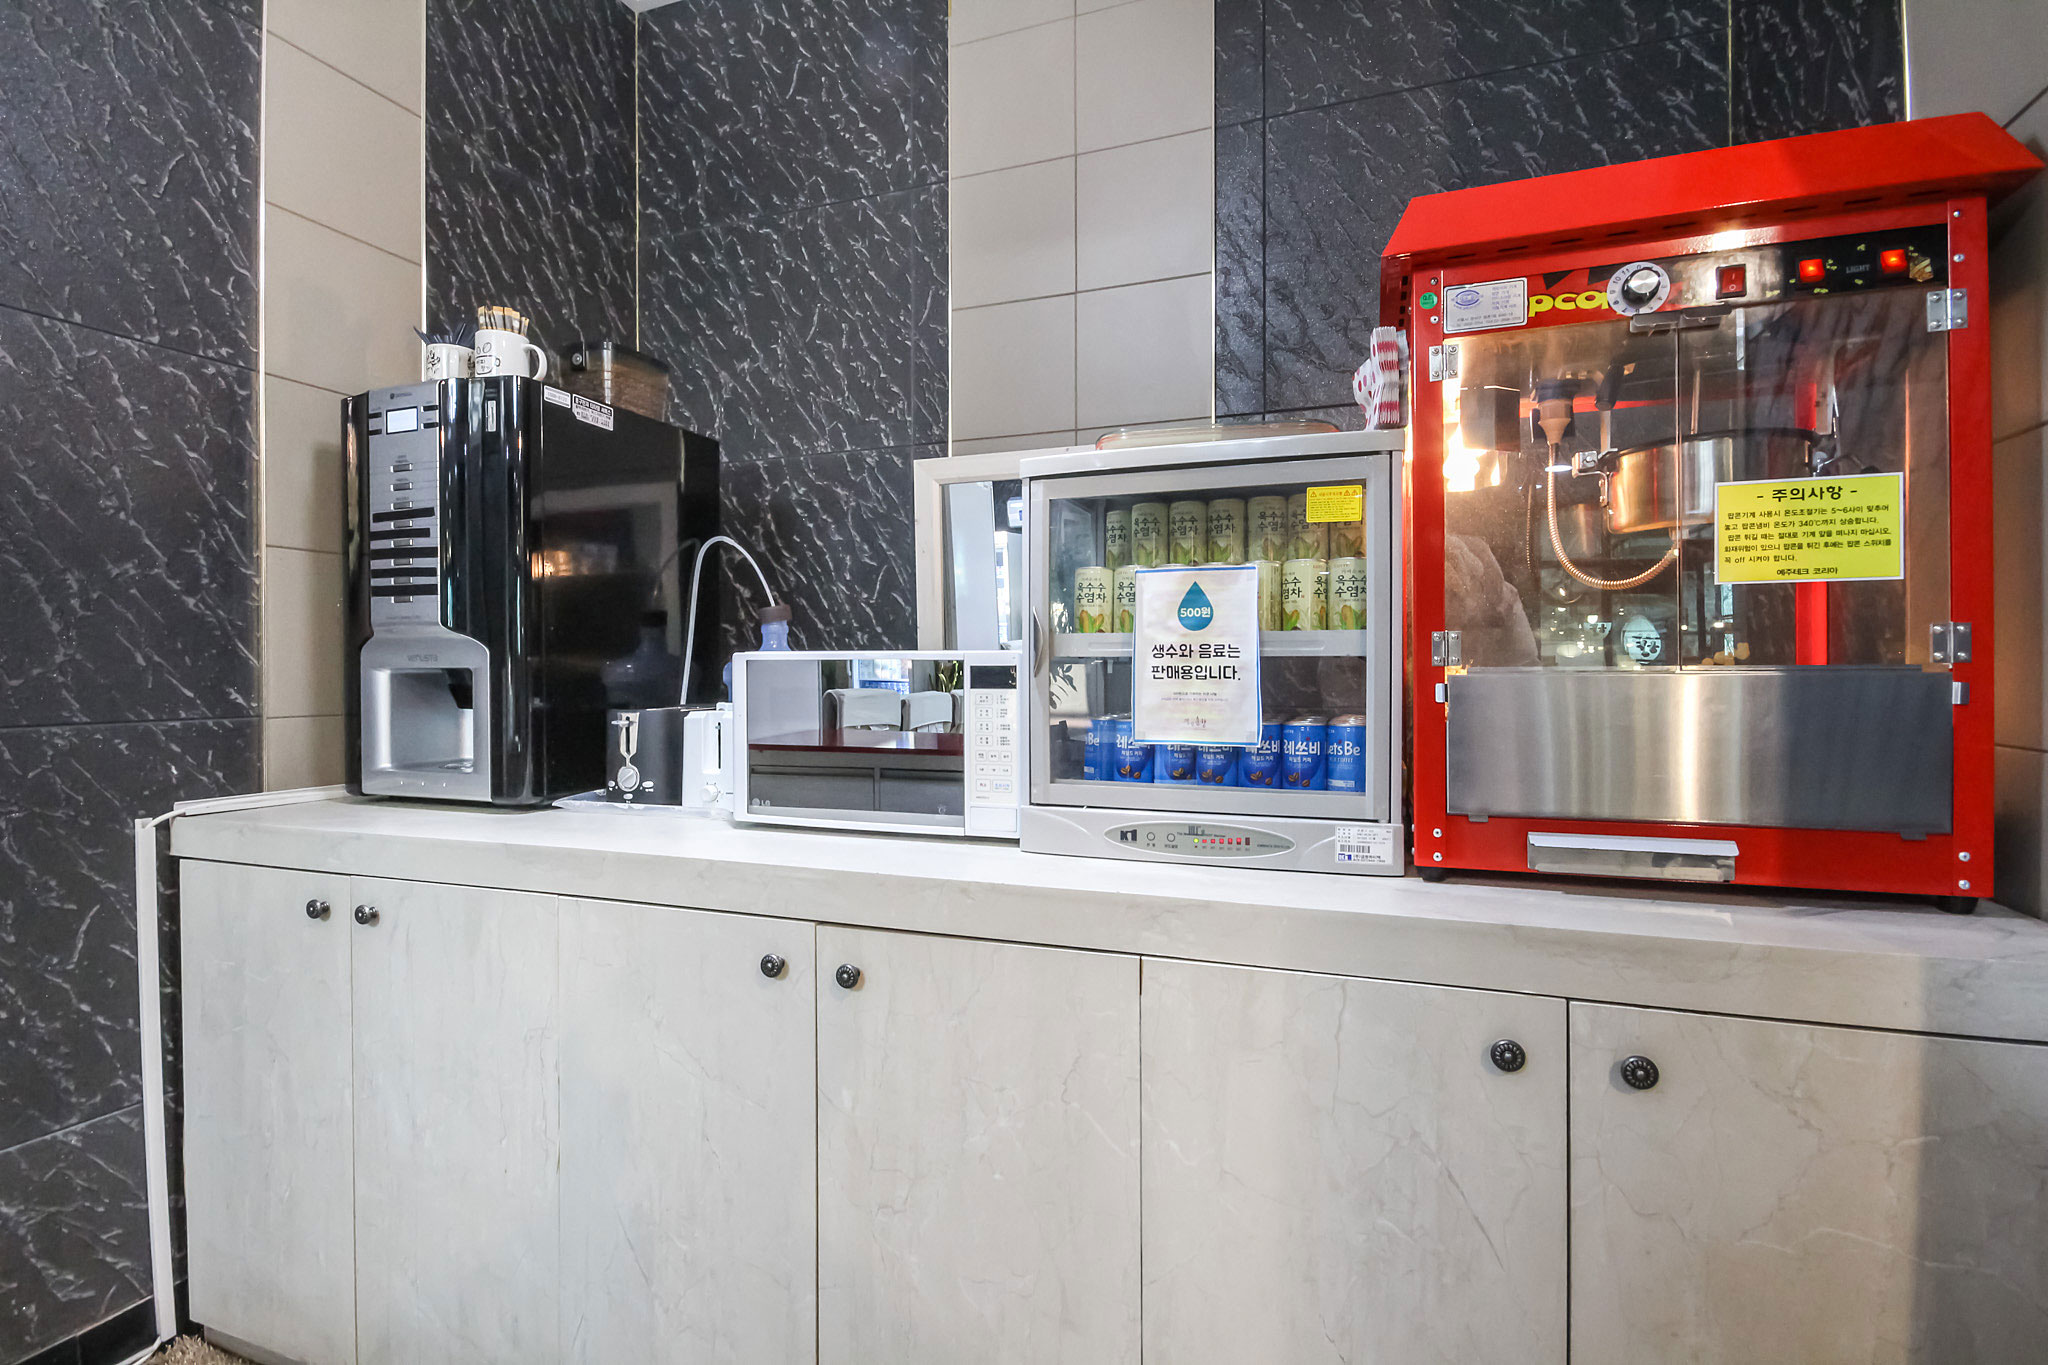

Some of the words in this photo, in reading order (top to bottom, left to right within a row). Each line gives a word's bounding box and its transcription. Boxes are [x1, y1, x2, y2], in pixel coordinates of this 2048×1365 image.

[1846, 264, 1870, 273] LIGHT
[1772, 486, 1843, 502] 주의사항
[1728, 511, 1755, 519] 팝콘기계
[1759, 510, 1780, 518] 사용시
[1728, 534, 1741, 542] 팝콘
[1077, 582, 1106, 592] 옥수수
[1117, 582, 1135, 591] 옥수
[1283, 577, 1301, 587] 수수
[1076, 592, 1106, 603] 수염차
[1117, 592, 1135, 603] 수염
[1282, 587, 1302, 599] 염차
[1180, 607, 1211, 617] 500원
[1152, 644, 1194, 658] 생수와
[1199, 644, 1241, 658] 음료는
[1152, 665, 1241, 681] 판매용입니다.
[1283, 740, 1320, 755] 레쓰비
